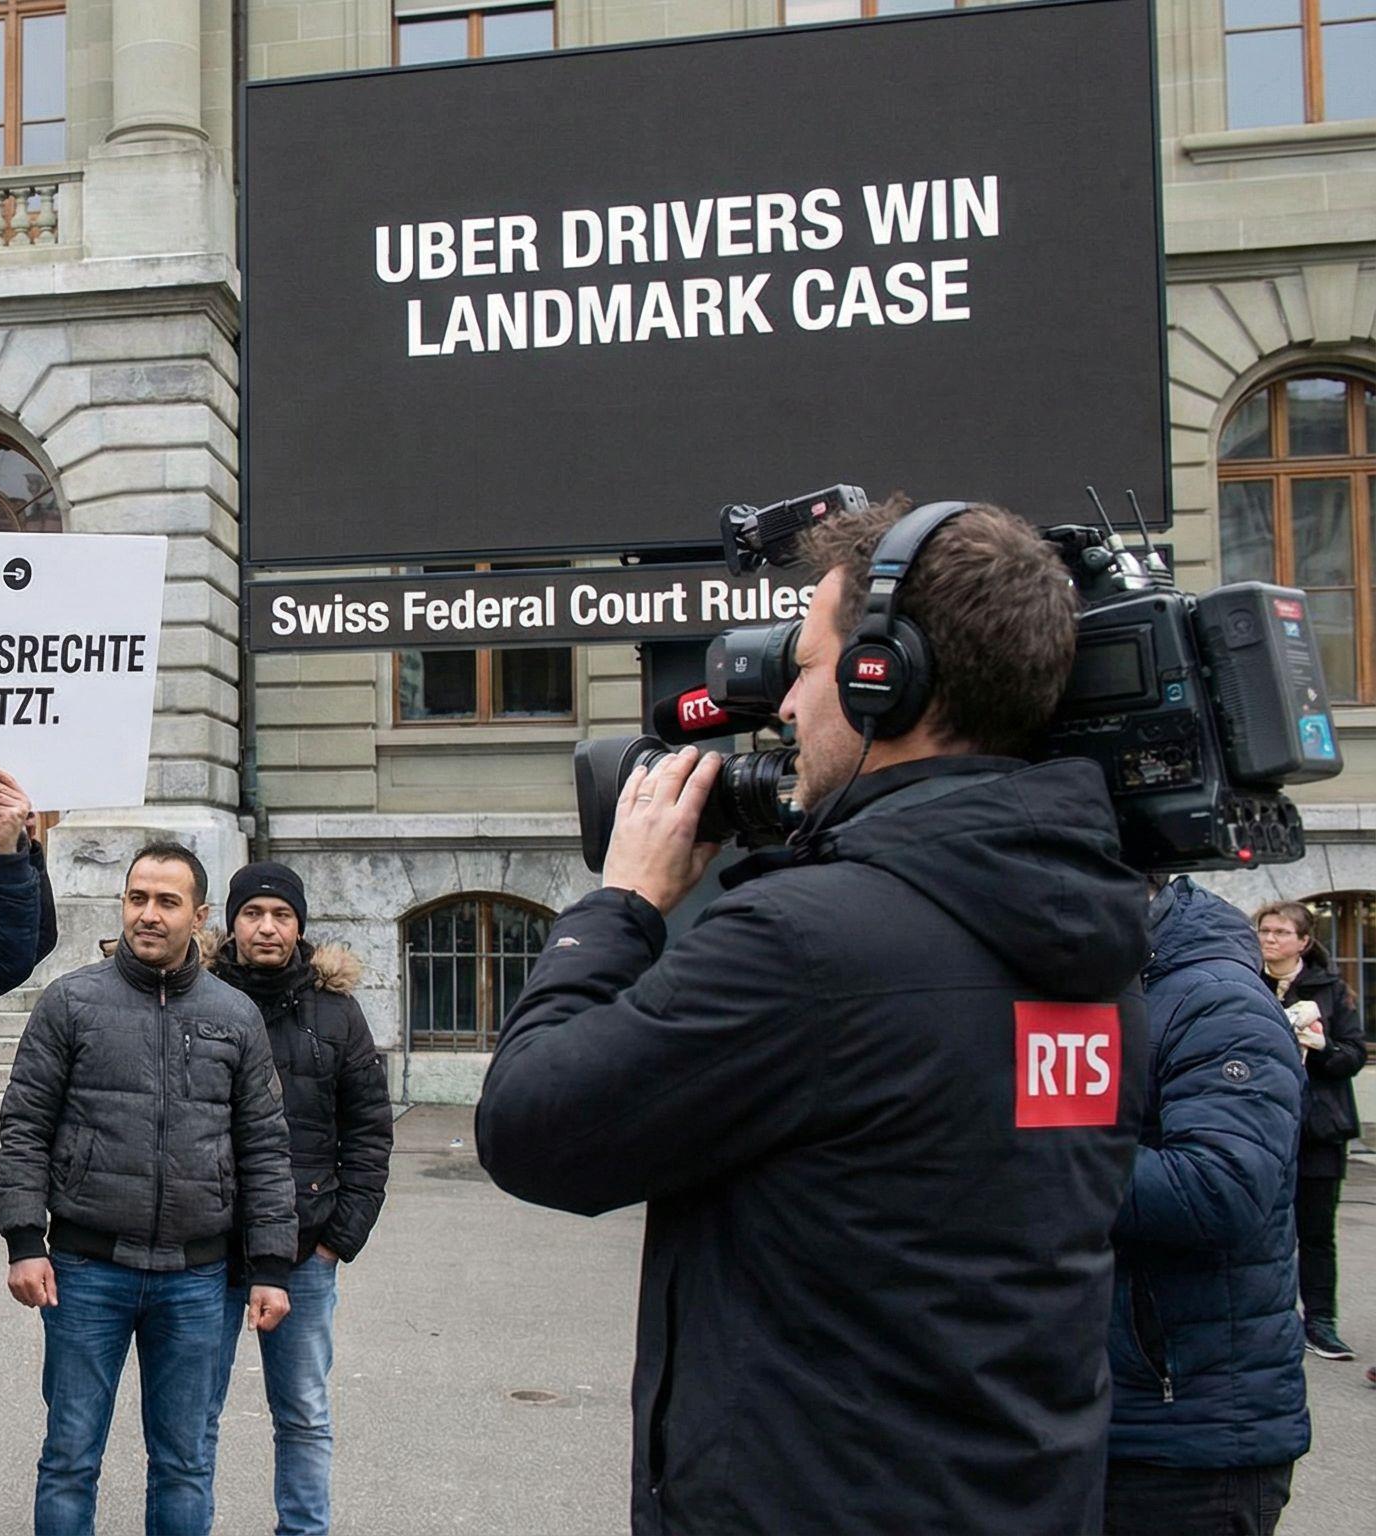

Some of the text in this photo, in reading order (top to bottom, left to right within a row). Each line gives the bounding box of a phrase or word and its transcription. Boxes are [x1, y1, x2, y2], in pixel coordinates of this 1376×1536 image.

[375, 175, 999, 283] UBER DRIVERS WIN
[407, 258, 971, 357] LANDMARK CASE
[271, 577, 817, 636] Swiss Federal Court Rules
[682, 696, 721, 721] RTS
[1027, 1033, 1111, 1096] RTS
